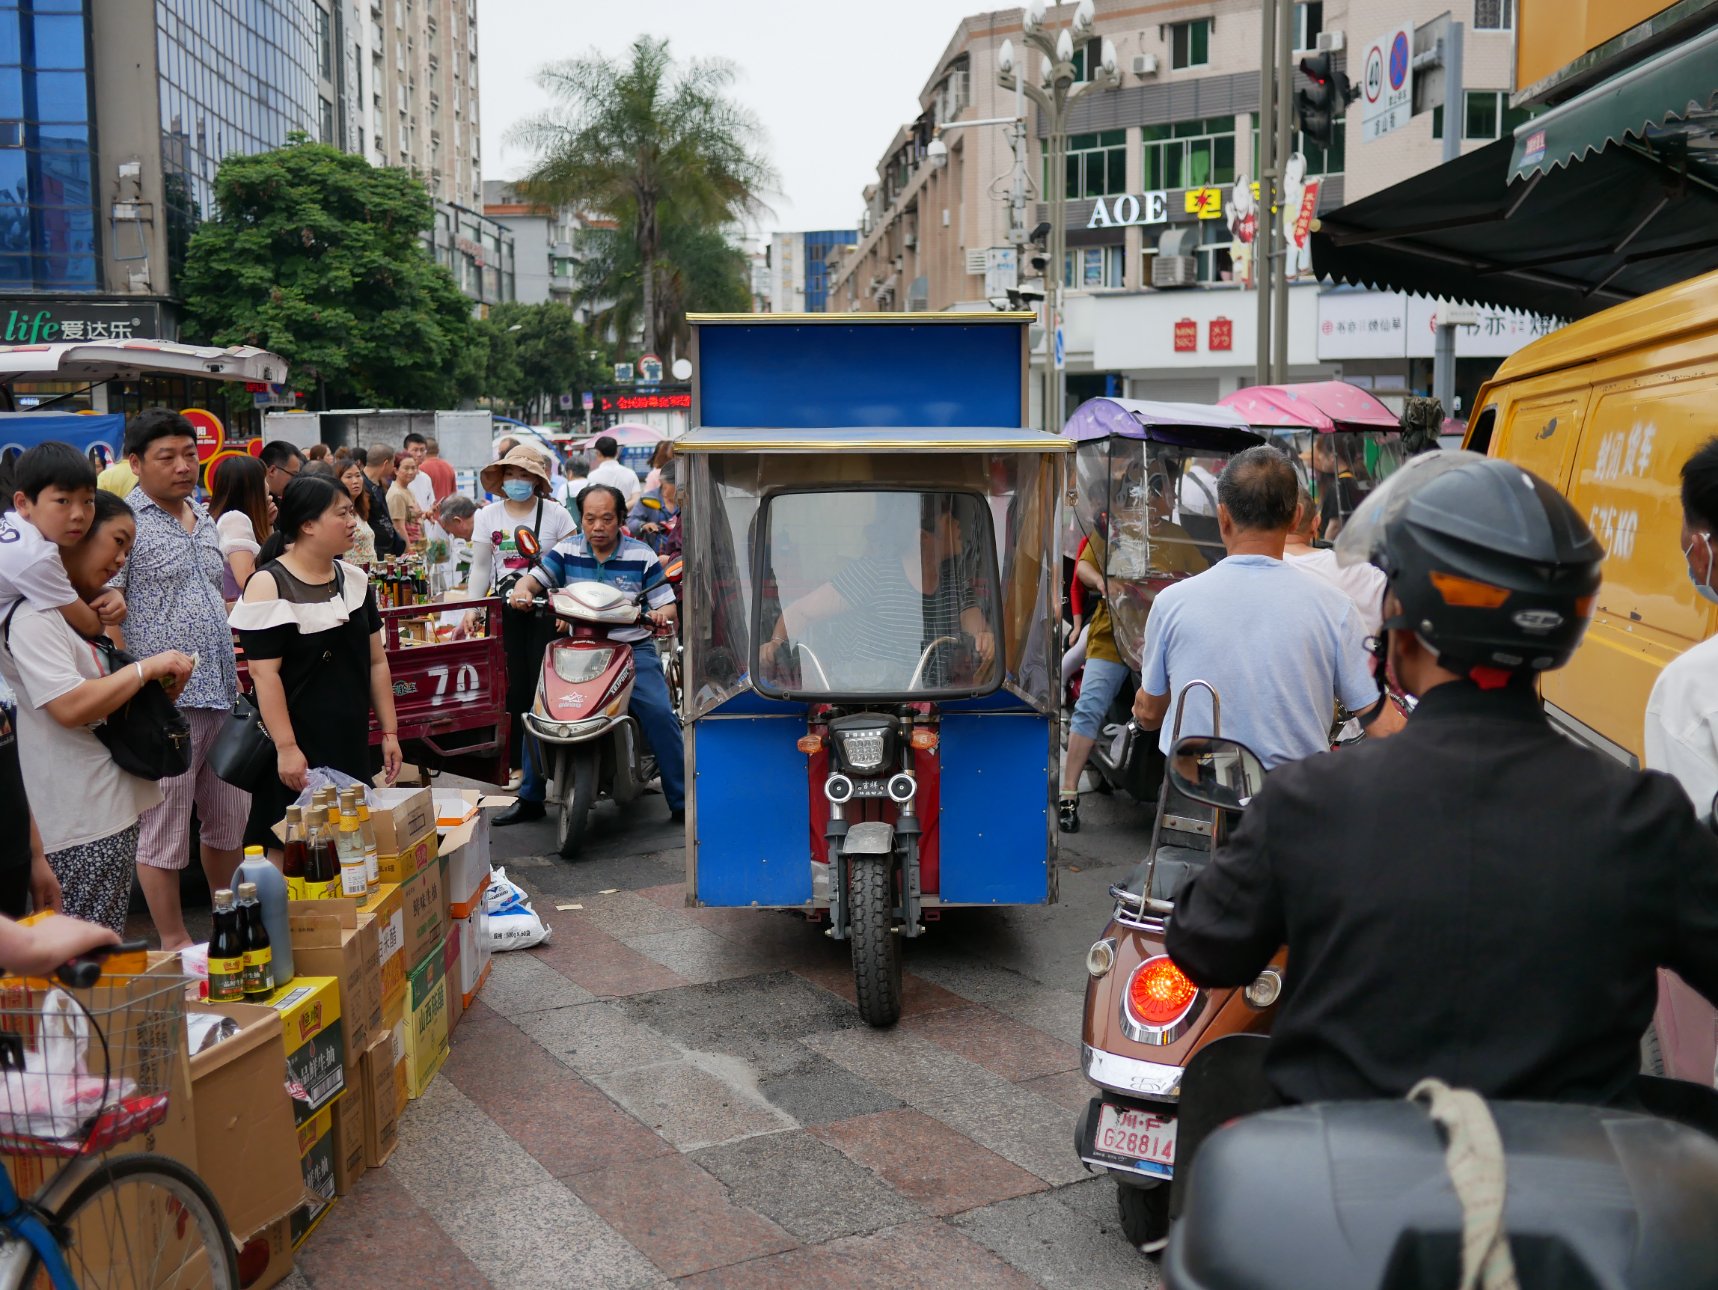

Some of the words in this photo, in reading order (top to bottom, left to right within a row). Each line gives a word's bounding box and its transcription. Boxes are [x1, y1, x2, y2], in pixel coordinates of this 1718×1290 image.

[1369, 61, 1380, 86] 40
[1086, 190, 1168, 229] AOE
[5, 310, 60, 345] life
[61, 320, 133, 340] 爱达乐
[428, 663, 480, 706] 70
[419, 982, 445, 1036] 山西陈醋
[1104, 1128, 1173, 1160] G28814
